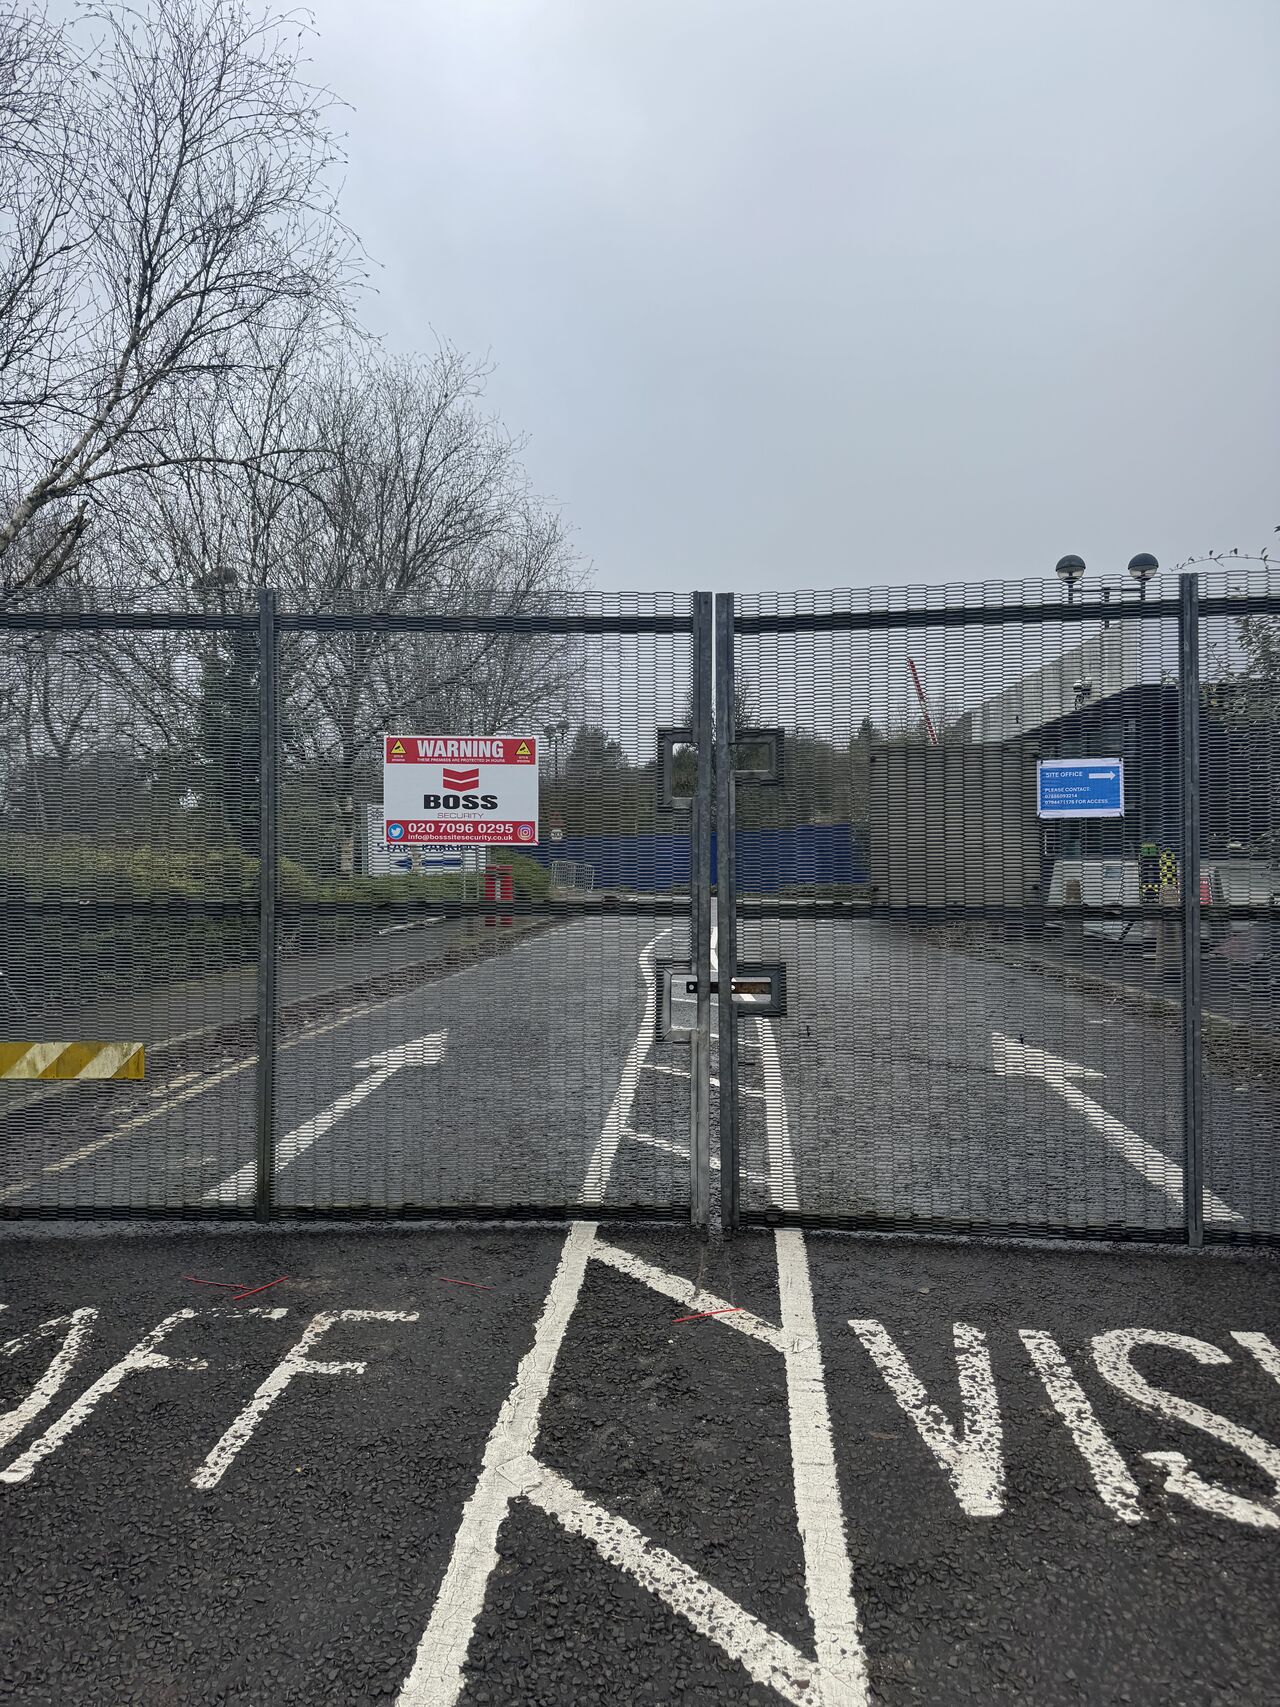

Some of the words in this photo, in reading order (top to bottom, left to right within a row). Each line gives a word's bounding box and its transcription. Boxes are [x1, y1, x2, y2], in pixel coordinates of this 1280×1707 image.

[417, 740, 504, 758] WARNING
[423, 794, 498, 810] BOSS
[408, 823, 435, 833] 020
[439, 823, 474, 833] 7096
[478, 823, 514, 834] 0295
[408, 833, 513, 842] info@bosssitesecurity.co.uk
